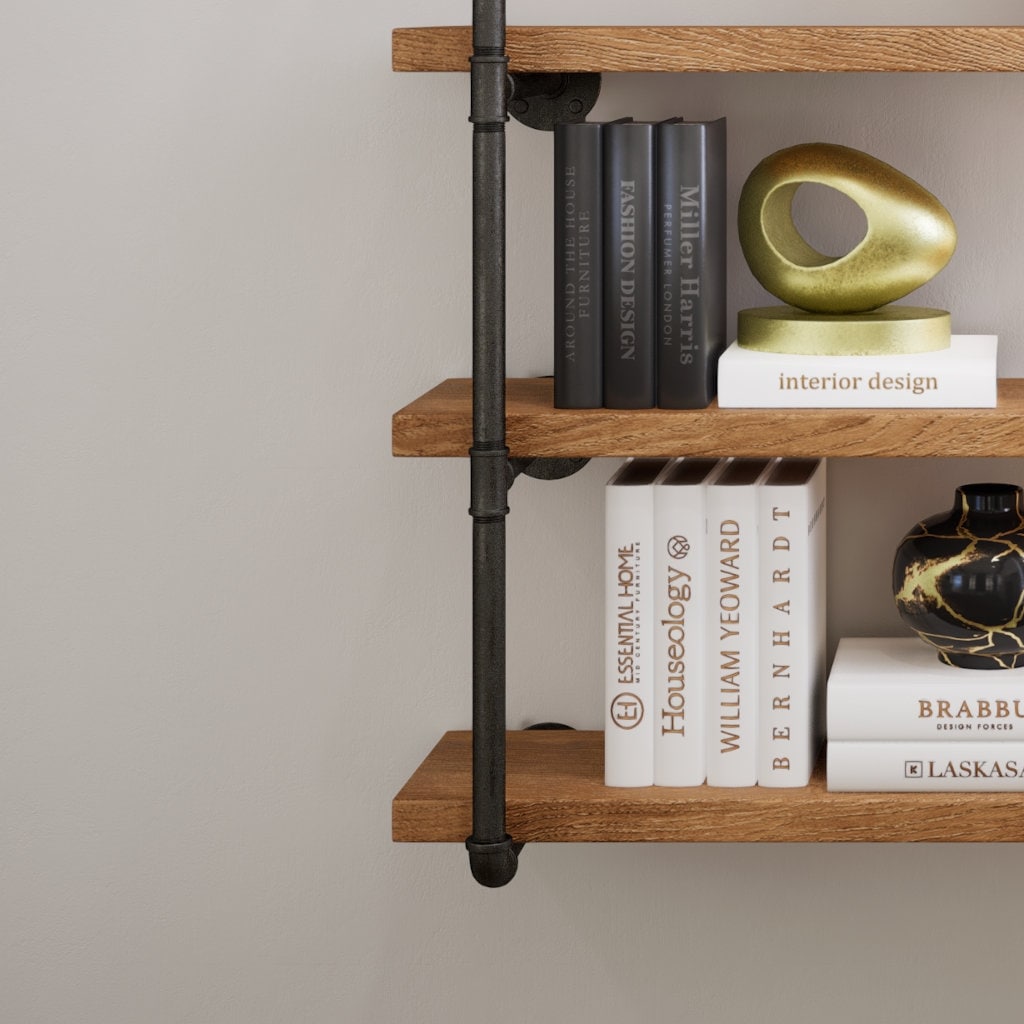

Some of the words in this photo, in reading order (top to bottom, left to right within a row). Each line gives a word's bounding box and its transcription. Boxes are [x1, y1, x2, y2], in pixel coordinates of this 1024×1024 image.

[565, 166, 576, 228] HOUSE
[620, 180, 635, 274] FASHION
[680, 185, 700, 269] Miller
[565, 237, 576, 274] THE
[579, 210, 590, 318] FURNITURE
[664, 204, 673, 275] PERFUMER
[565, 283, 576, 362] AROUND
[620, 279, 635, 361] DESIGN
[664, 284, 673, 346] LONDON
[680, 277, 700, 365] Harris
[778, 373, 862, 390] interior
[868, 372, 938, 394] design
[617, 543, 634, 598] HOME
[719, 519, 740, 641] YEOWARD
[617, 601, 634, 684] ESSENTIAL
[661, 565, 691, 737] Houseology
[772, 507, 790, 771] BERNHARDT
[720, 650, 740, 754] WILLIAM
